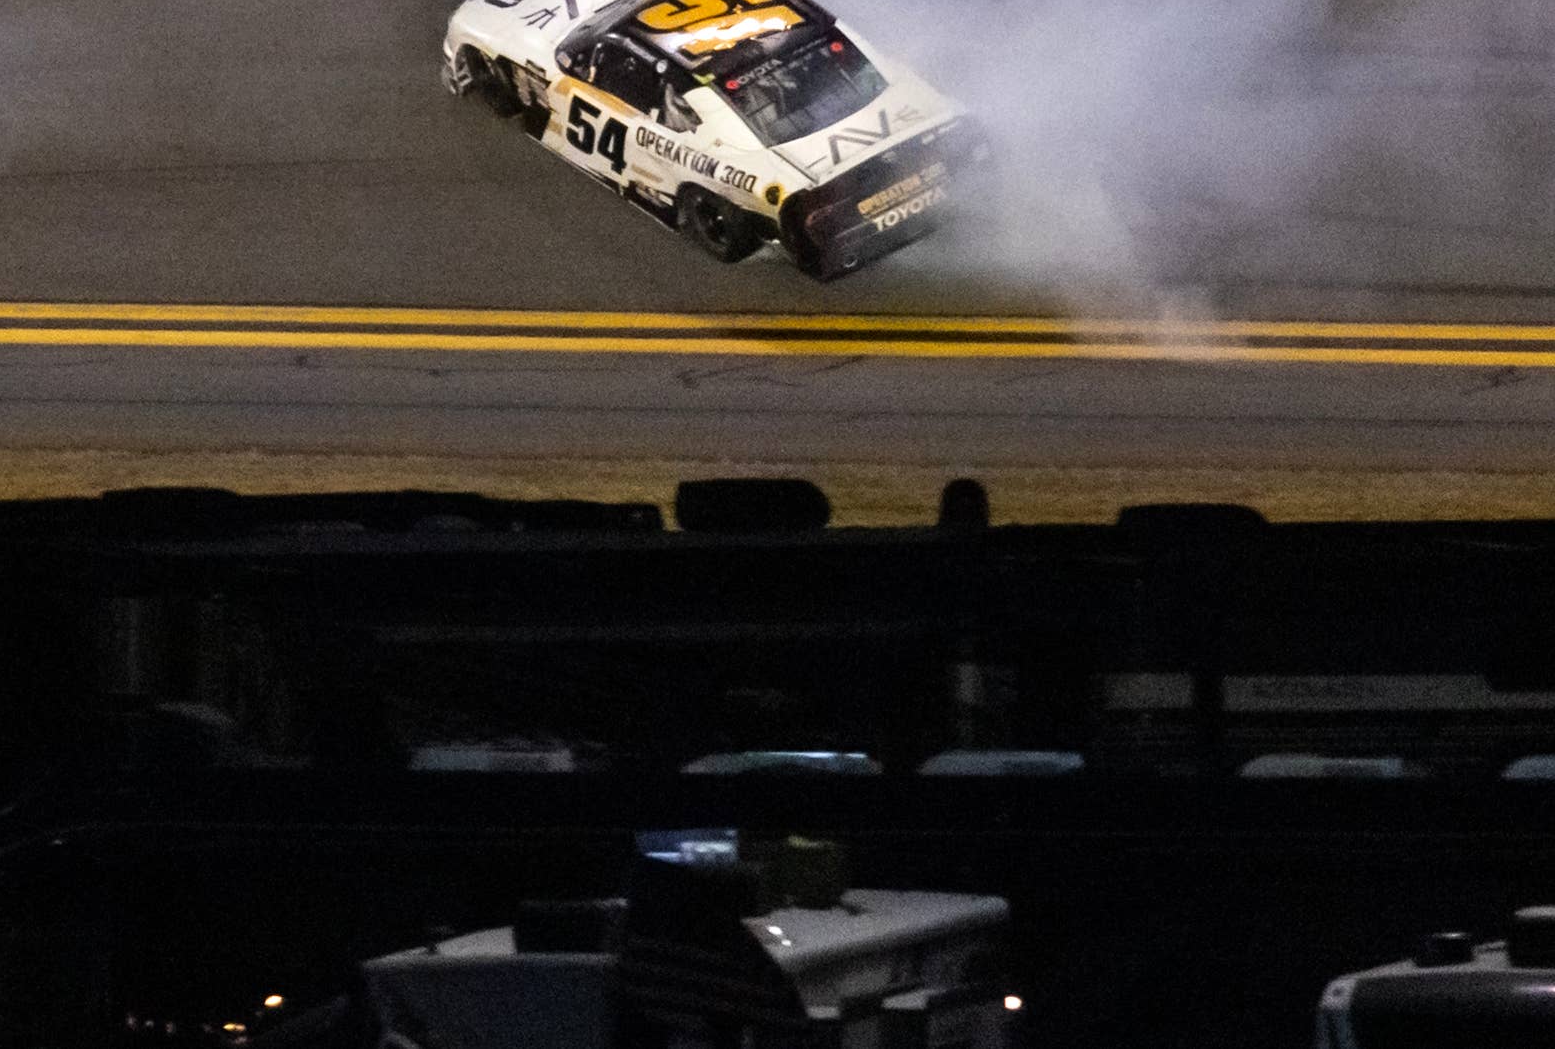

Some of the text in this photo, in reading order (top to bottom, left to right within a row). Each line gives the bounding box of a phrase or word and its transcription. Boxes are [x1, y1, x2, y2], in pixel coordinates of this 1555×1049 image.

[734, 58, 783, 85] OYOTA
[566, 95, 629, 175] 54
[635, 125, 721, 180] OPERATION
[719, 164, 759, 193] 300
[873, 186, 946, 232] TOYOTA
